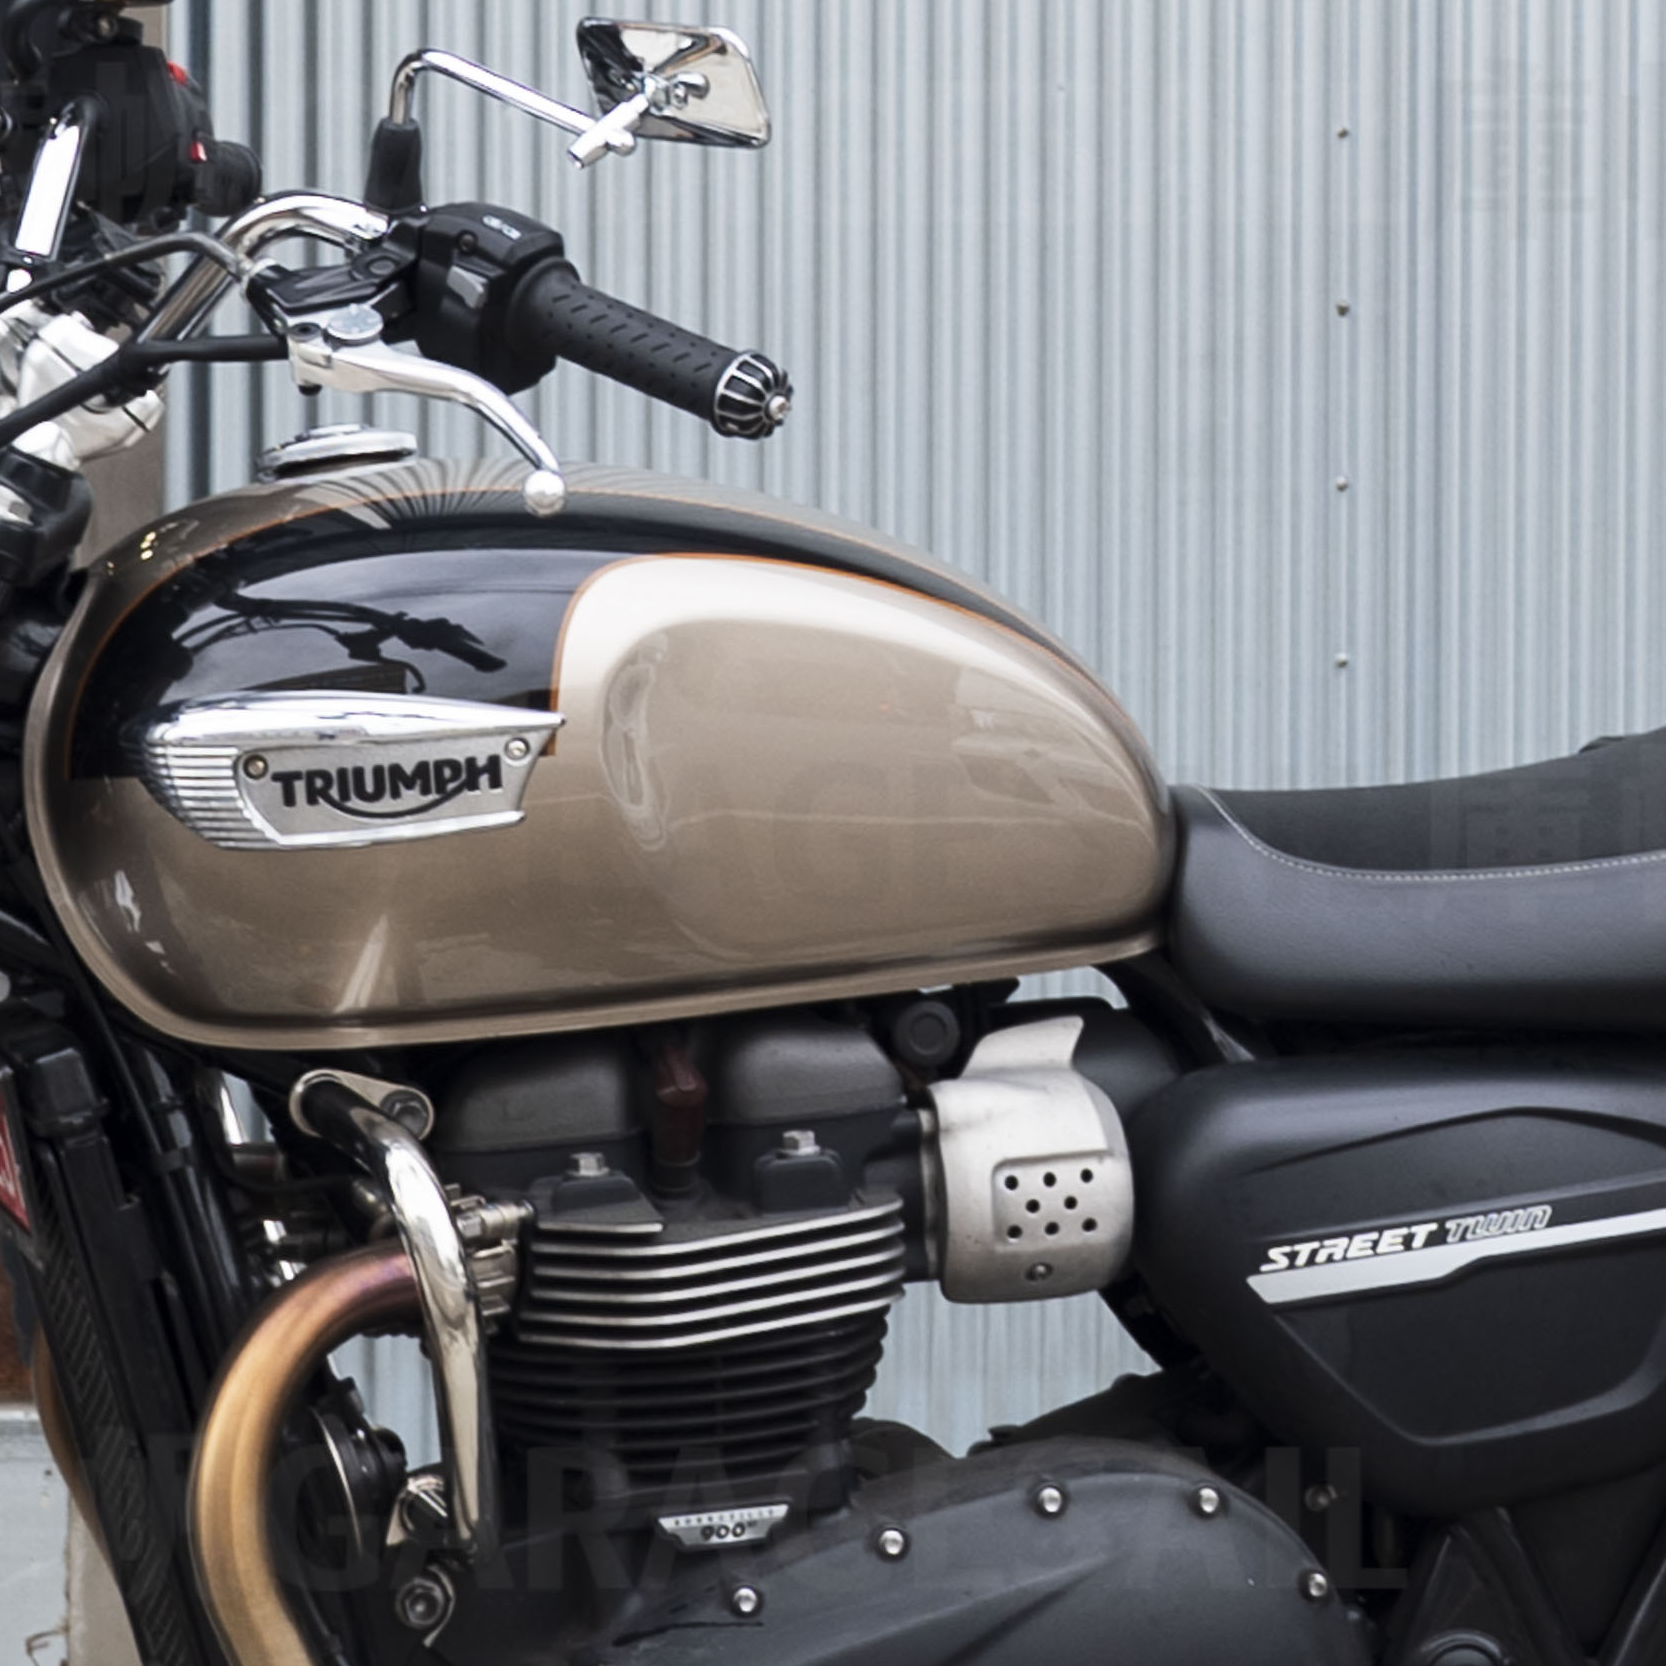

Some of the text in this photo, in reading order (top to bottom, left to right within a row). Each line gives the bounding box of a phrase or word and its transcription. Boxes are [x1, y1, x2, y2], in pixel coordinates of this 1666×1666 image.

[270, 753, 504, 818] TRIUMPH
[1259, 1222, 1439, 1273] STREET
[701, 1522, 746, 1542] 900
